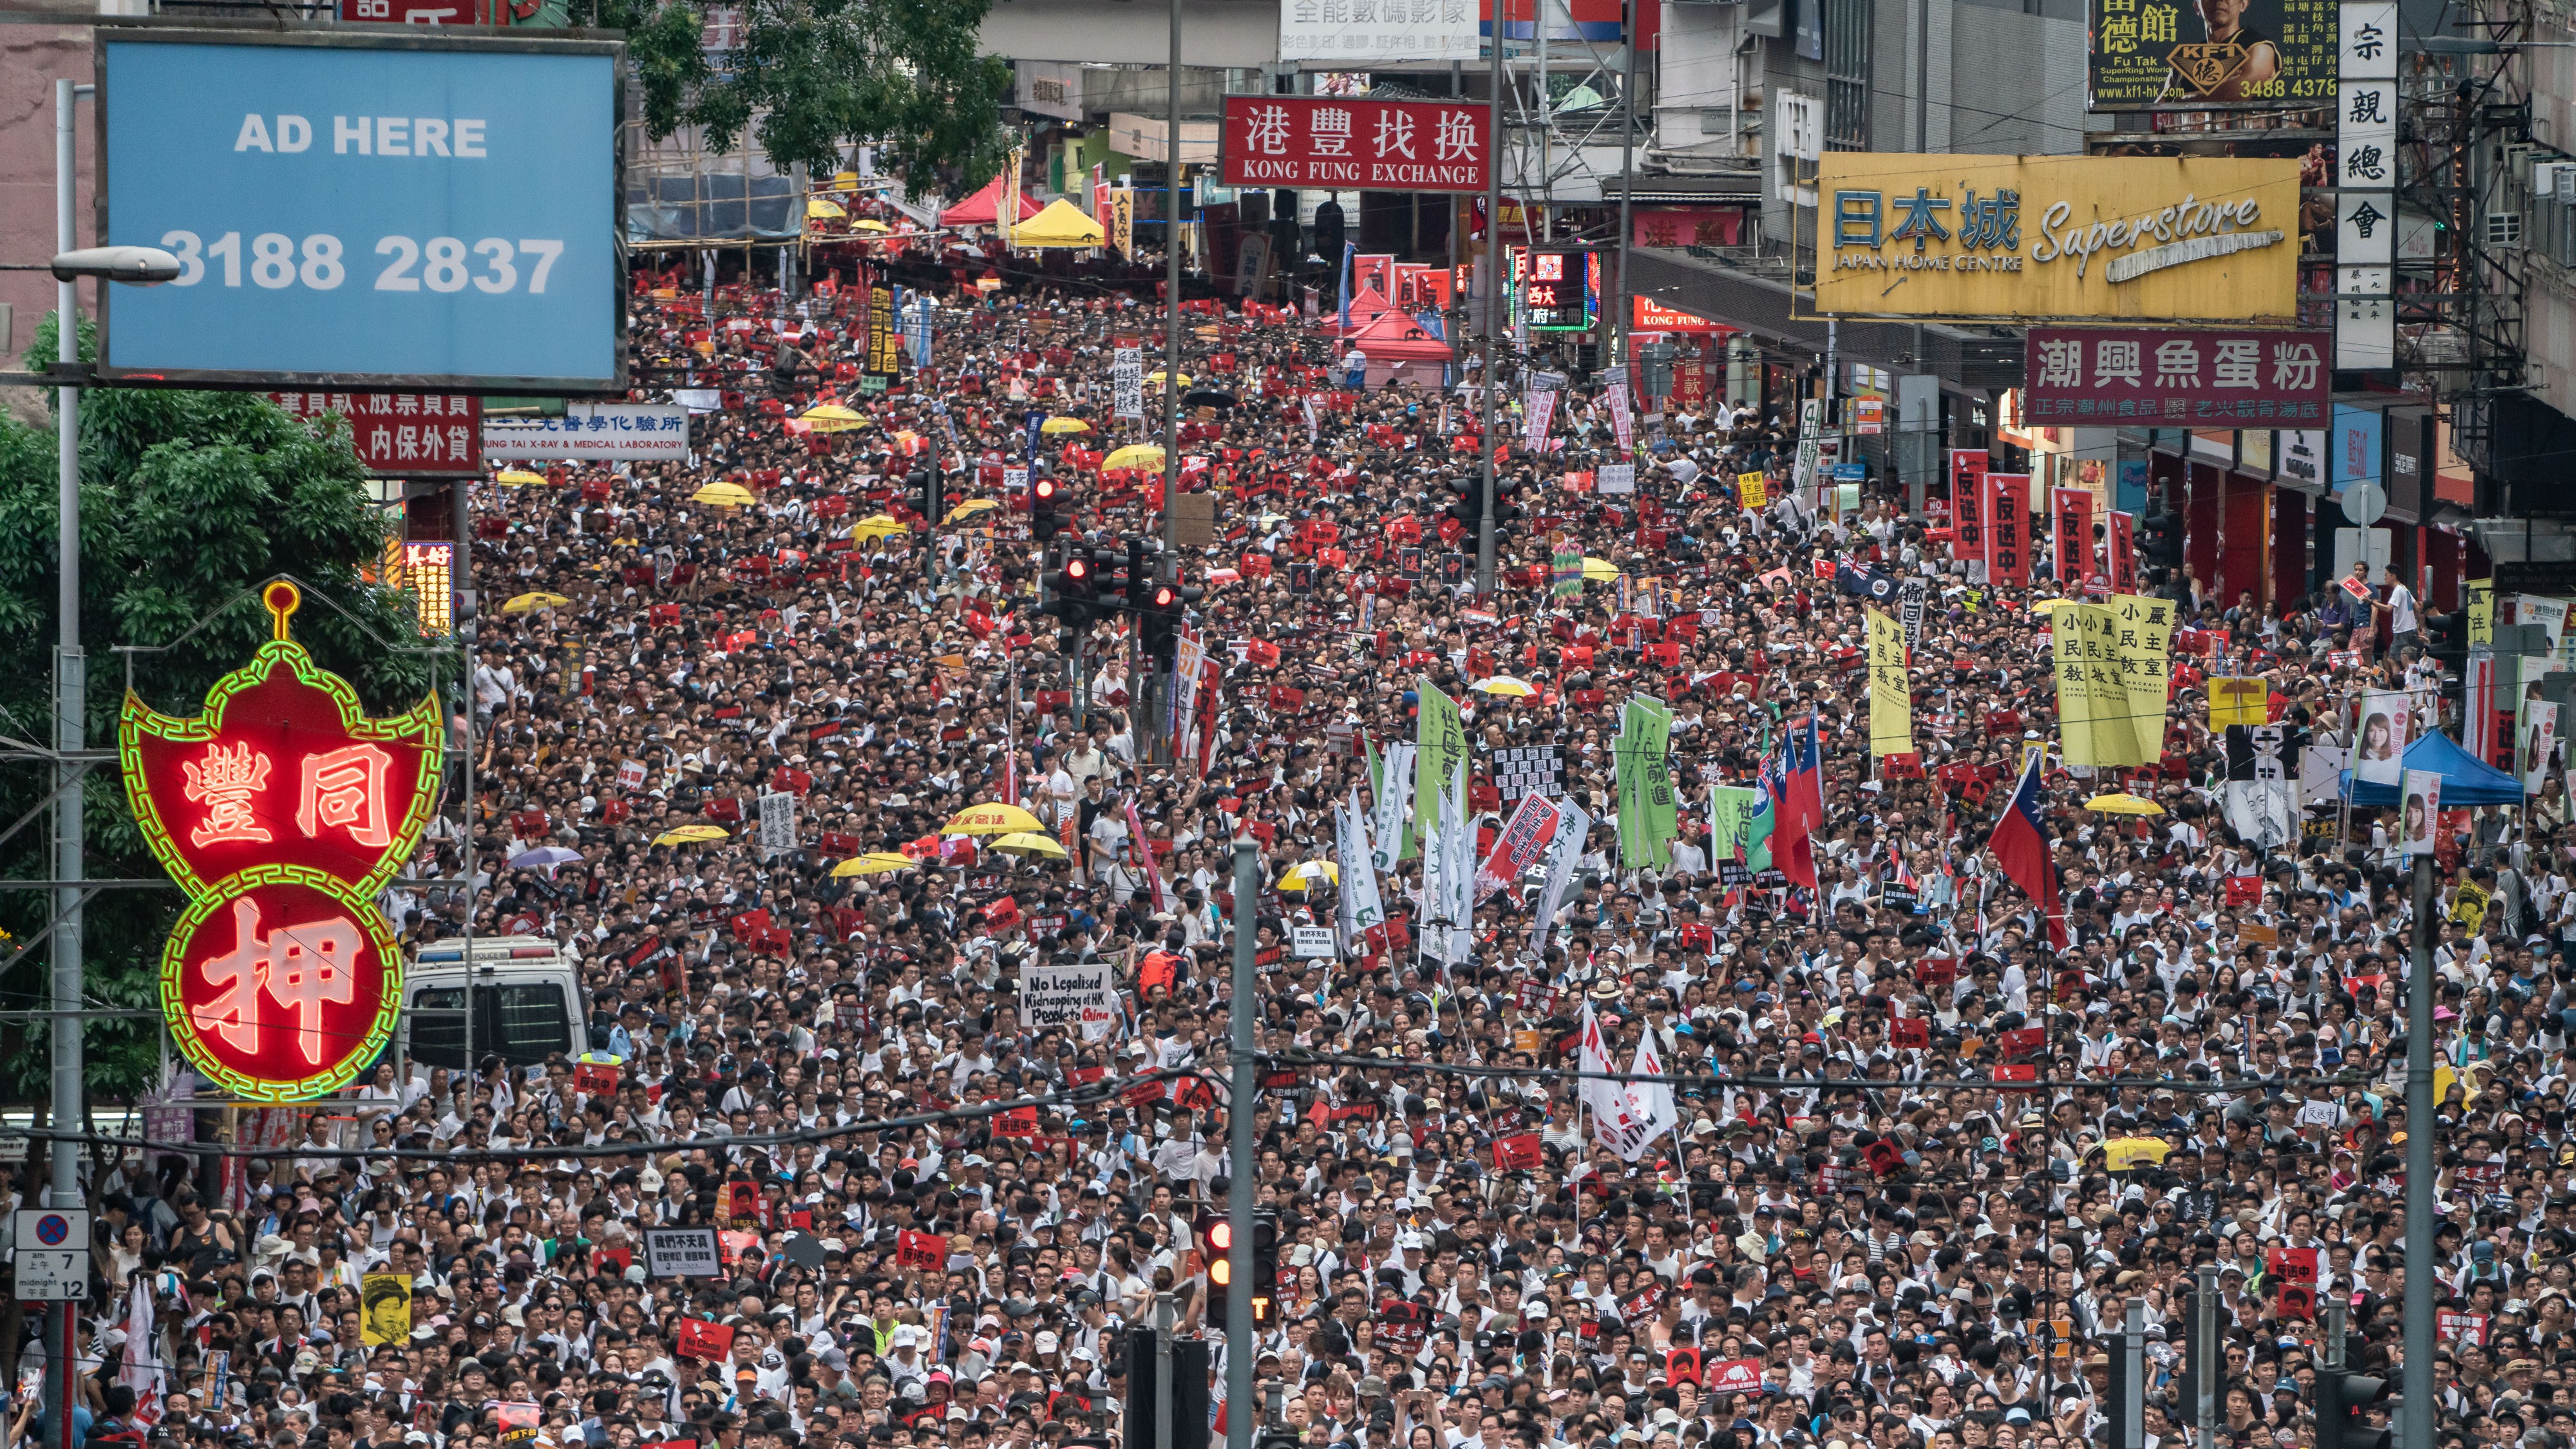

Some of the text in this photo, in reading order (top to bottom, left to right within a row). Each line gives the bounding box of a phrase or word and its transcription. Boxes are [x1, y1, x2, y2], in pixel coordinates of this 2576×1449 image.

[1294, 0, 1466, 24] 全能數碼影像
[2183, 46, 2235, 59] KF1
[2114, 56, 2157, 67] Fu Tak
[2100, 66, 2145, 75] SuperRing
[2103, 75, 2168, 84] Championships
[2098, 84, 2185, 99] www.kf1-hk.com
[2240, 79, 2338, 98] 3488 4378
[234, 113, 488, 158] AD HERE
[1244, 105, 1479, 162] 港豐找換
[2345, 22, 2388, 239] 宗親總會
[1243, 160, 1479, 185] KONG FUNG EXCHANGE
[1833, 187, 2019, 251] 日本城
[2031, 193, 2262, 278] Superstore
[159, 230, 564, 294] 3188 2837
[1833, 253, 2023, 272] JAPAN HOME CENTRE
[1643, 316, 1705, 326] KONG FUNG
[2037, 337, 2322, 391] 潮興魚蛋粉
[2034, 397, 2157, 418] 正宗潮州食品
[2196, 399, 2319, 419] 老火靚骨湯底
[511, 440, 683, 451] TAI X-RAY & MEDICAL LABORATORY
[1743, 473, 1761, 484] 林鄭
[1745, 483, 1762, 493] 下台
[1743, 495, 1766, 504] 反送中
[1928, 500, 1943, 509] NO
[1956, 472, 1980, 547] 反送中
[1996, 496, 2017, 573] 反送中
[2062, 511, 2081, 584] 反送中
[1237, 684, 1267, 698] 反送中
[1273, 696, 1296, 707] 反送中
[2393, 697, 2412, 755] 楊 雪盈
[1495, 748, 1553, 761] 無德無能
[1504, 759, 1561, 774] 何以服人
[1888, 764, 1913, 775] 反送中
[907, 845, 933, 856] 反送中
[987, 913, 1014, 928] 反送中
[755, 938, 784, 952] 反送中
[474, 952, 498, 960] POLICE
[193, 895, 363, 1066] 押
[1029, 971, 1102, 994] No Legalised
[1921, 971, 1950, 982] 反送中
[1024, 990, 1105, 1009] Kidnapping of HK
[1031, 1007, 1109, 1025] People to China
[1895, 1032, 1922, 1044] 反送中
[580, 1075, 611, 1090] 反送中
[2307, 1106, 2335, 1122] 反送中
[999, 1119, 1031, 1132] 反送中
[2454, 1164, 2501, 1182] 反送中
[654, 1234, 708, 1249] 我們不天真
[62, 1254, 74, 1270] 7
[656, 1251, 682, 1262] 反對修訂
[903, 1247, 937, 1264] 反送中
[28, 1260, 50, 1271] 上午
[2276, 1264, 2310, 1277] 反送中
[18, 1278, 57, 1287] midnight
[61, 1280, 83, 1297] 12
[27, 1288, 48, 1298] 午夜
[1619, 1290, 1663, 1317] 反送中
[1376, 1321, 1425, 1340] 反送中
[685, 1337, 721, 1351] No China
